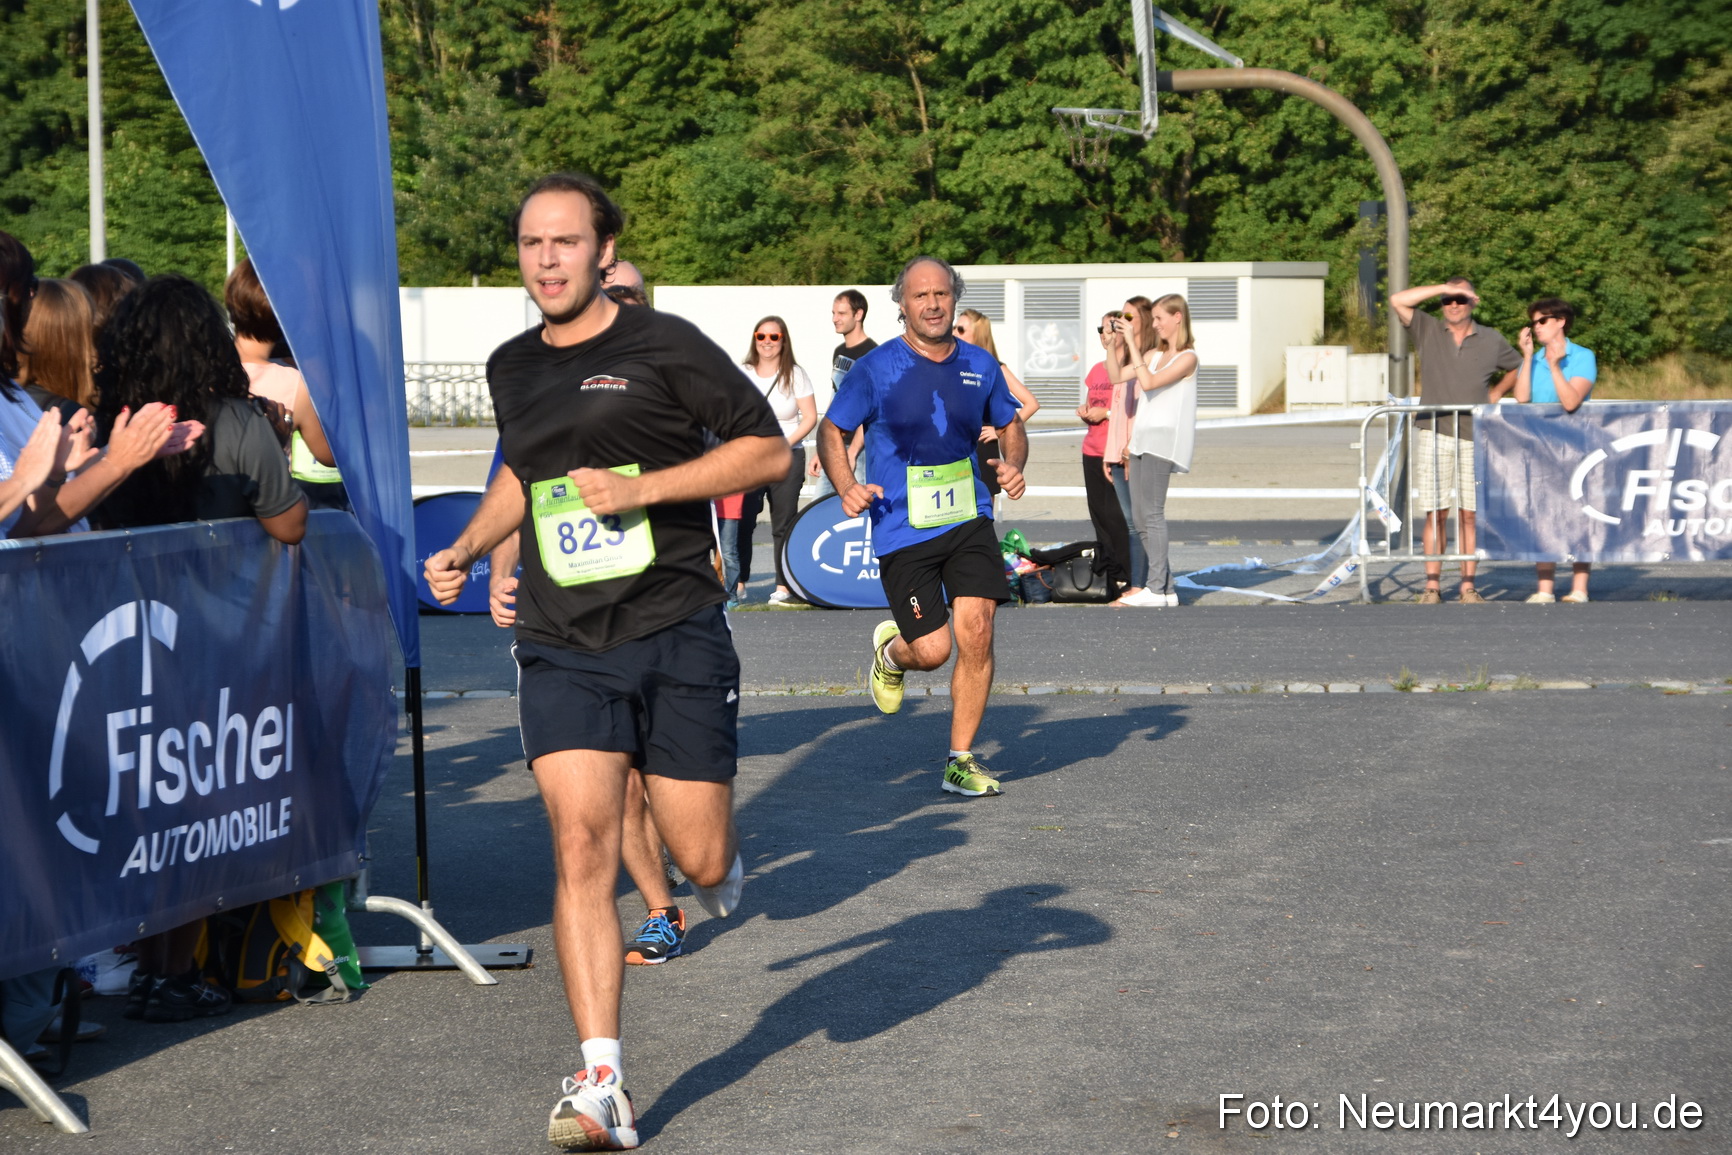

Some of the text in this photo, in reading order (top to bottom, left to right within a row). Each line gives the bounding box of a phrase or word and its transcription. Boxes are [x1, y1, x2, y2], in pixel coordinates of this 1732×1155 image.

[931, 488, 955, 510] 11
[557, 513, 626, 555] 823
[1642, 517, 1732, 537] AUTO
[119, 796, 292, 878] AUTOMOBILE
